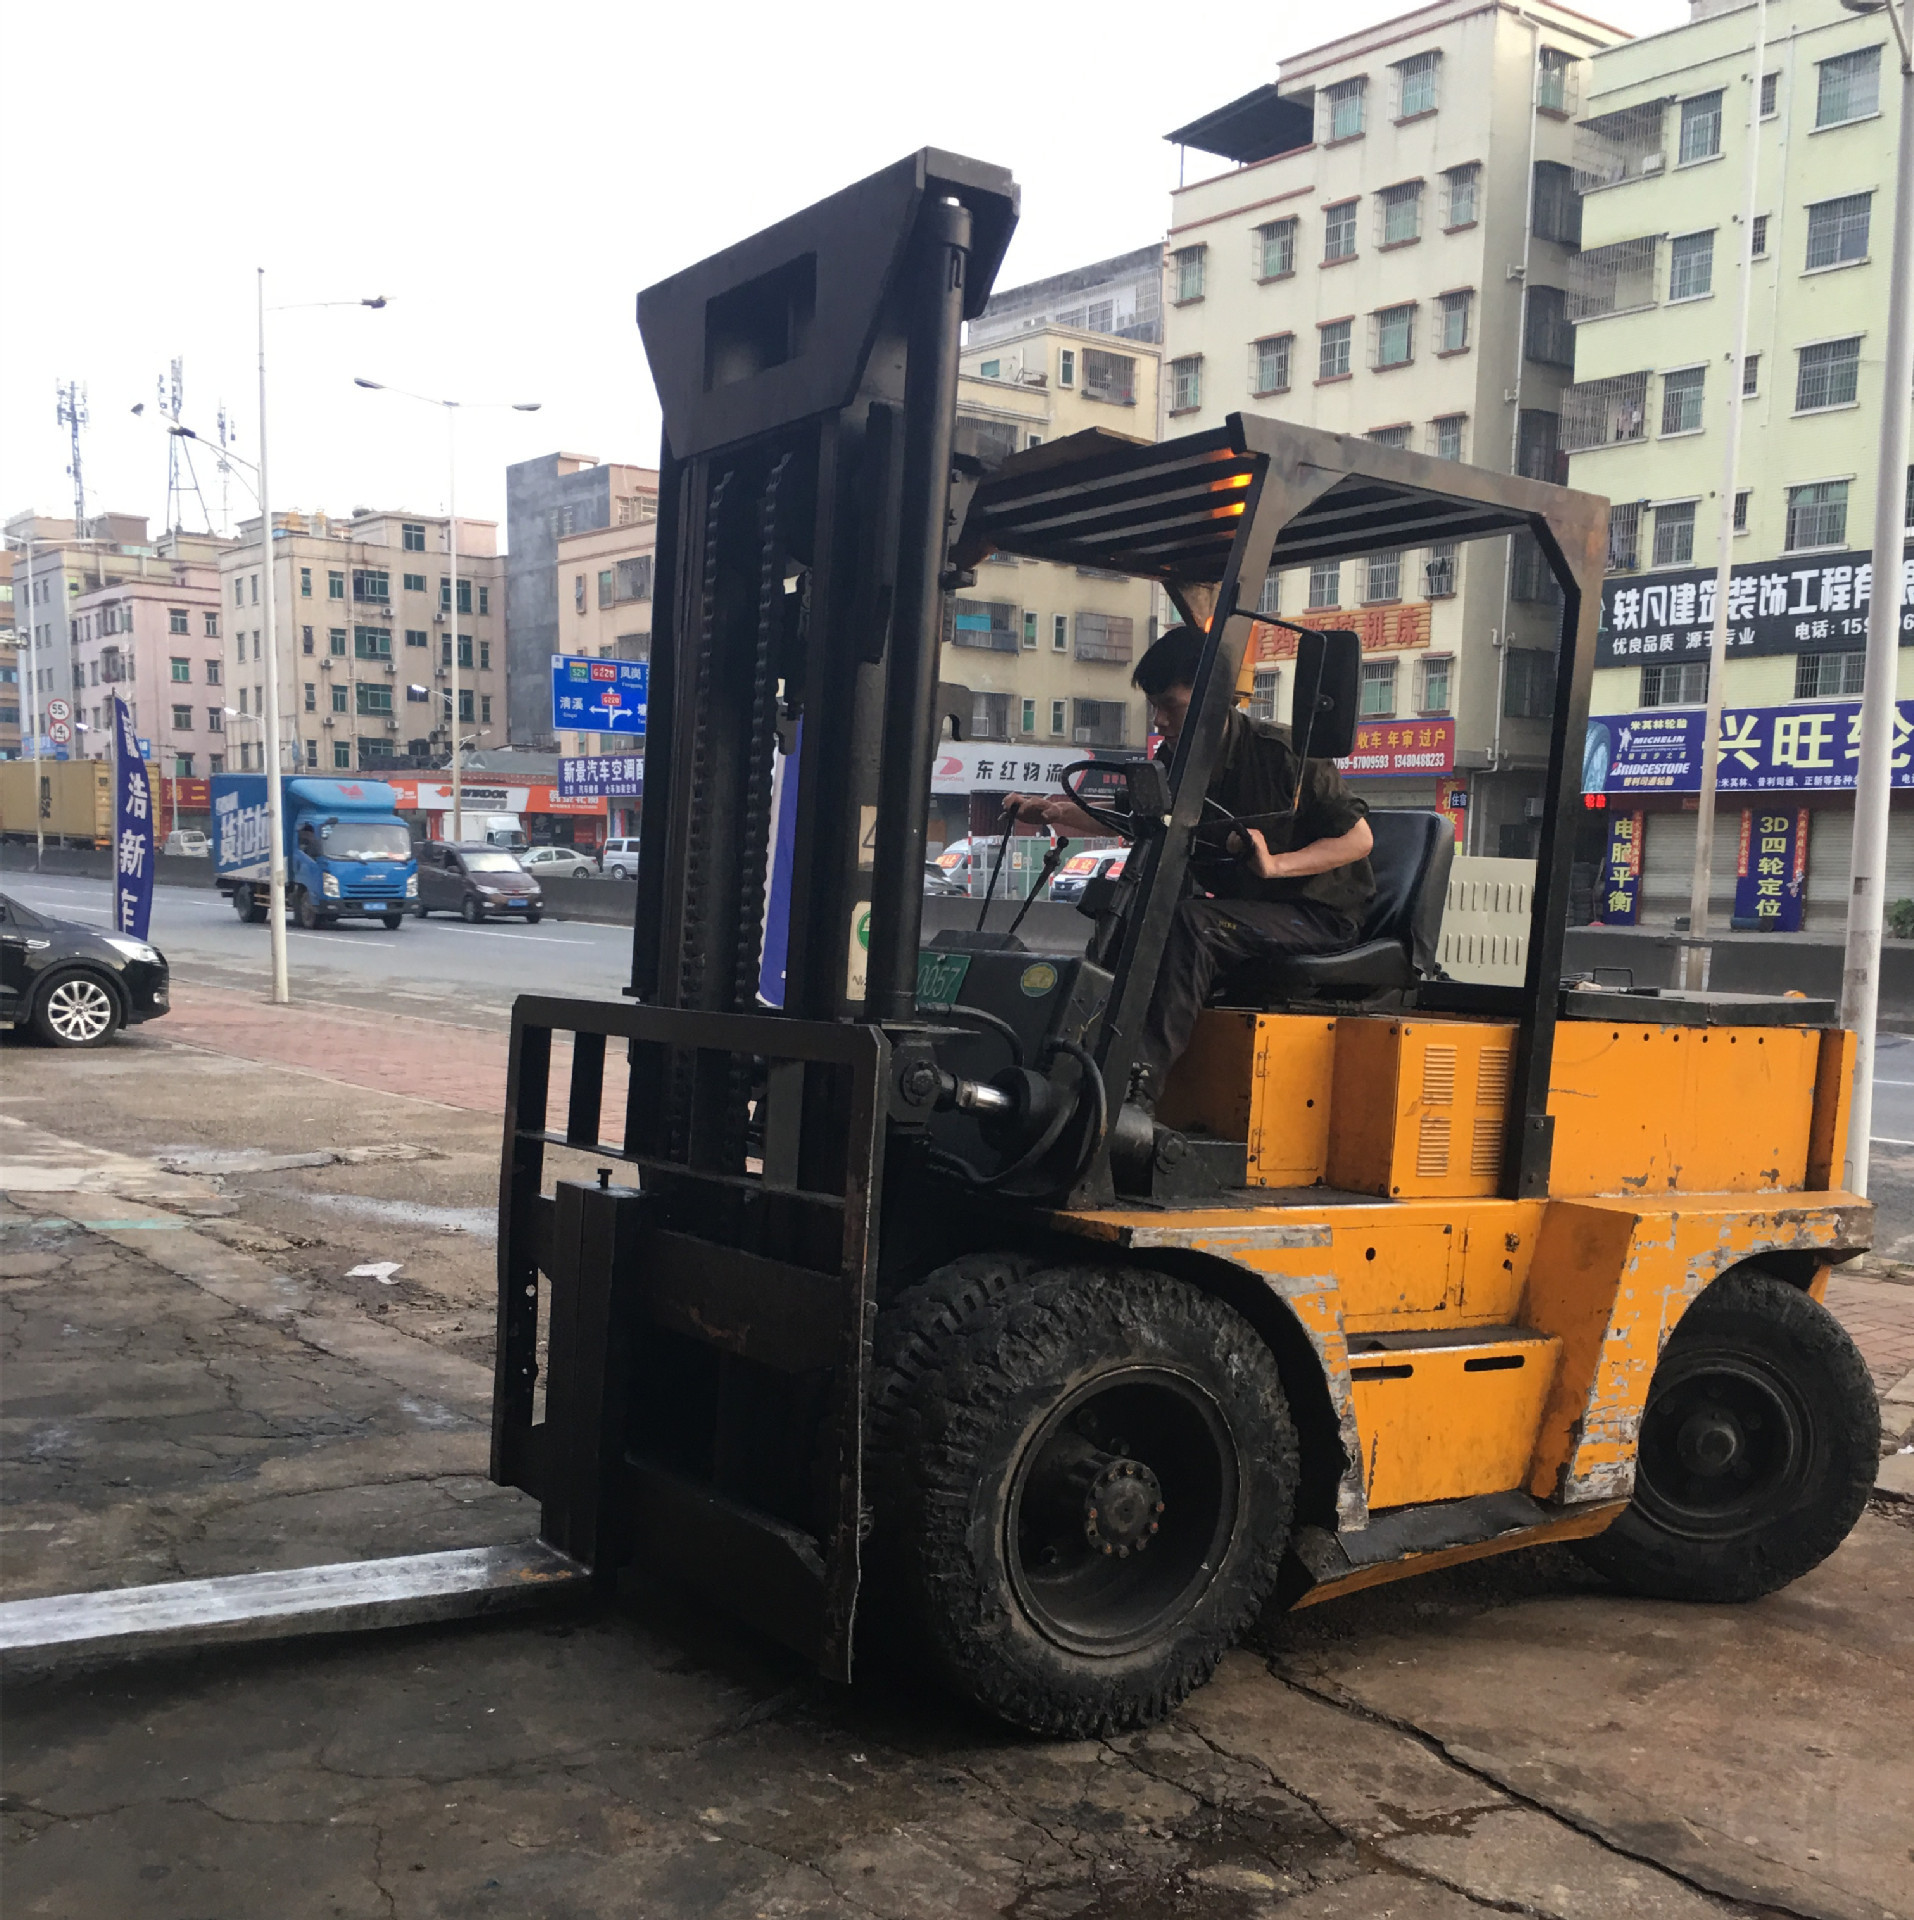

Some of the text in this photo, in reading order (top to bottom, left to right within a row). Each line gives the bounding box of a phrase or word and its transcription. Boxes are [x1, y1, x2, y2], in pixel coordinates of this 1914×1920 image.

[1612, 633, 1675, 655] 优良品质
[1357, 727, 1446, 749] 收车 年审 过户
[1633, 735, 1686, 744] MICHELIN
[975, 759, 1063, 783] 东红物流
[1609, 761, 1691, 776] BRIDGESTONE
[1608, 817, 1635, 912] 电脑平衡
